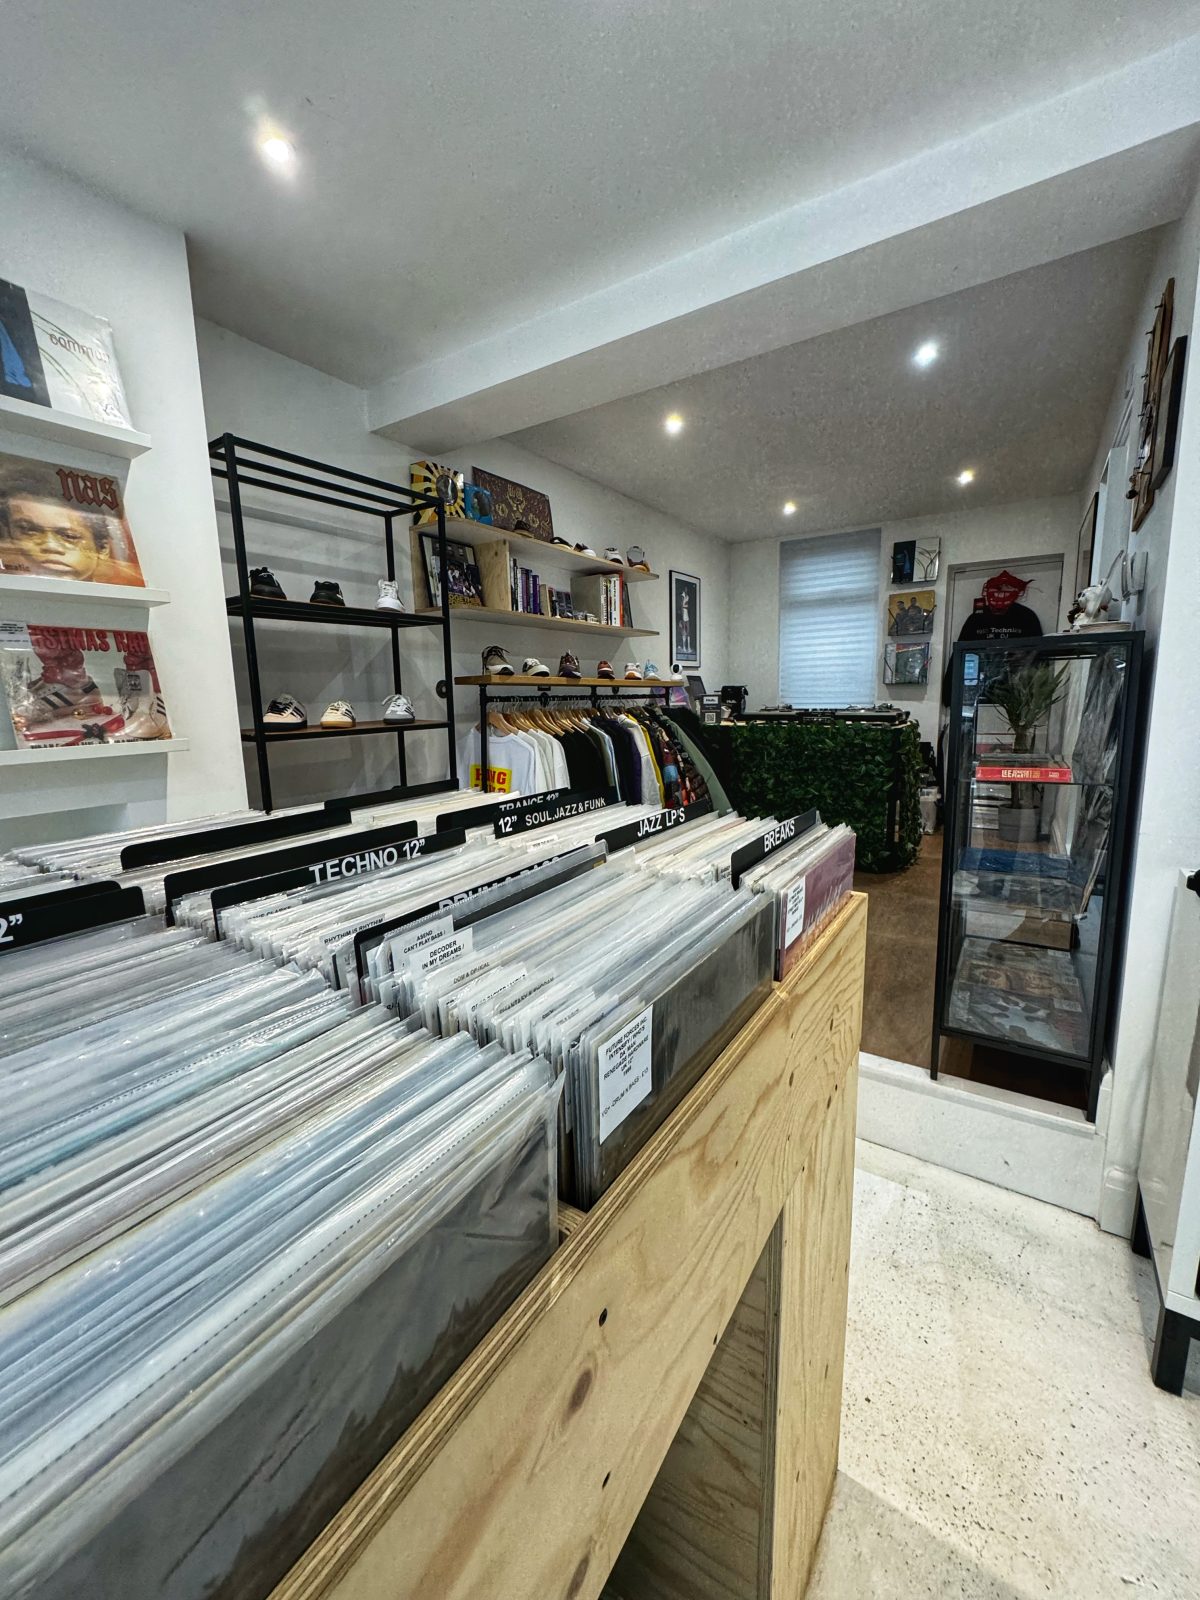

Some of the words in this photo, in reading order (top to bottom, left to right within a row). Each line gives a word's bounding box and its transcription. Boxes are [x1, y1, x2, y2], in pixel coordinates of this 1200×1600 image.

[56, 468, 119, 510] nas
[498, 815, 518, 833] 12”
[637, 814, 662, 837] JAZZ
[763, 820, 795, 853] BREAKS
[309, 847, 398, 885] TECHNO
[402, 838, 425, 860] 12”
[418, 937, 430, 947] PLAY
[429, 940, 457, 959] DECODER
[429, 957, 438, 967] MY
[438, 946, 462, 961] DREAMS
[605, 1036, 623, 1056] FUTURE
[623, 1022, 640, 1039] FORCES
